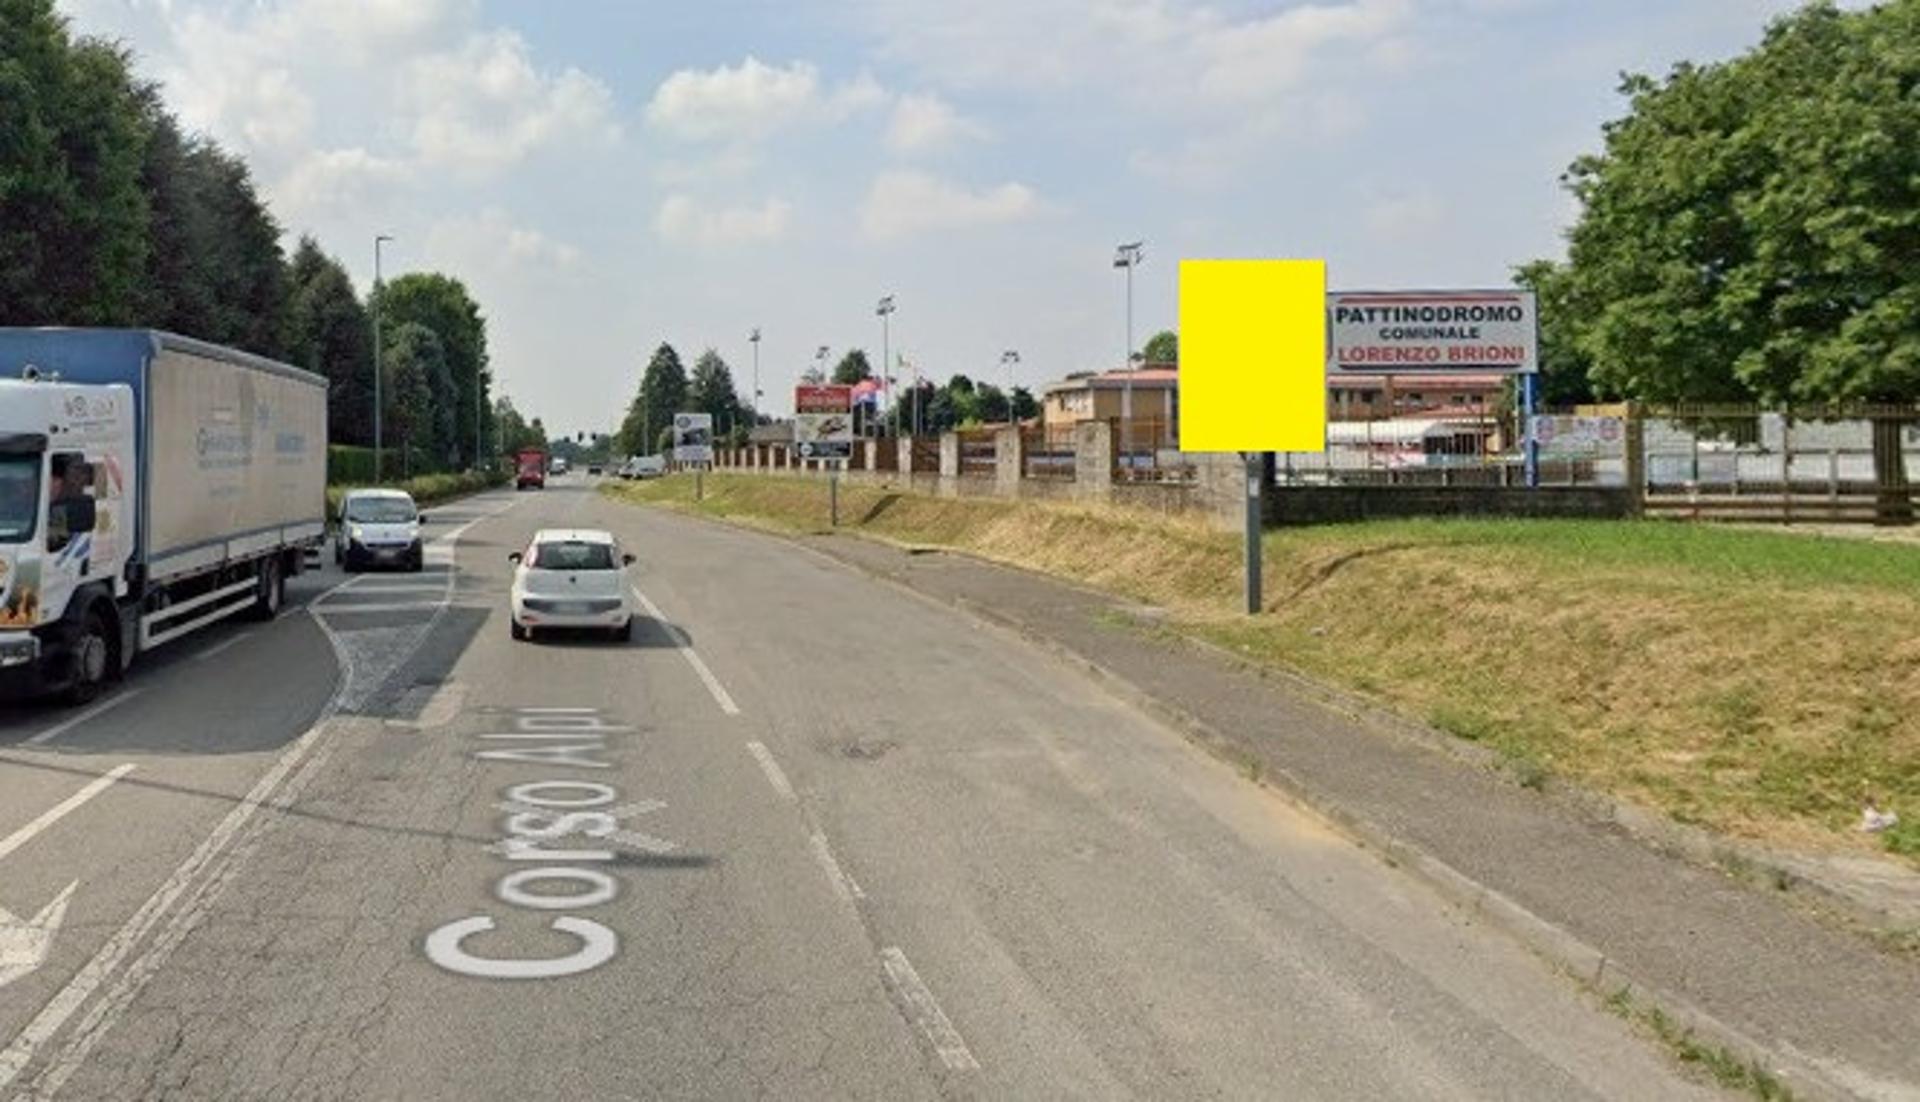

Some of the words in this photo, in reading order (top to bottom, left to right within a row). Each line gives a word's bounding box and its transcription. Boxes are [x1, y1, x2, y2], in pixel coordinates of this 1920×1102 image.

[1337, 306, 1522, 323] PATTINODROMO
[1380, 327, 1480, 340] COMUNALE
[1339, 347, 1440, 362] LORENZO
[1449, 346, 1524, 361] BRIONI
